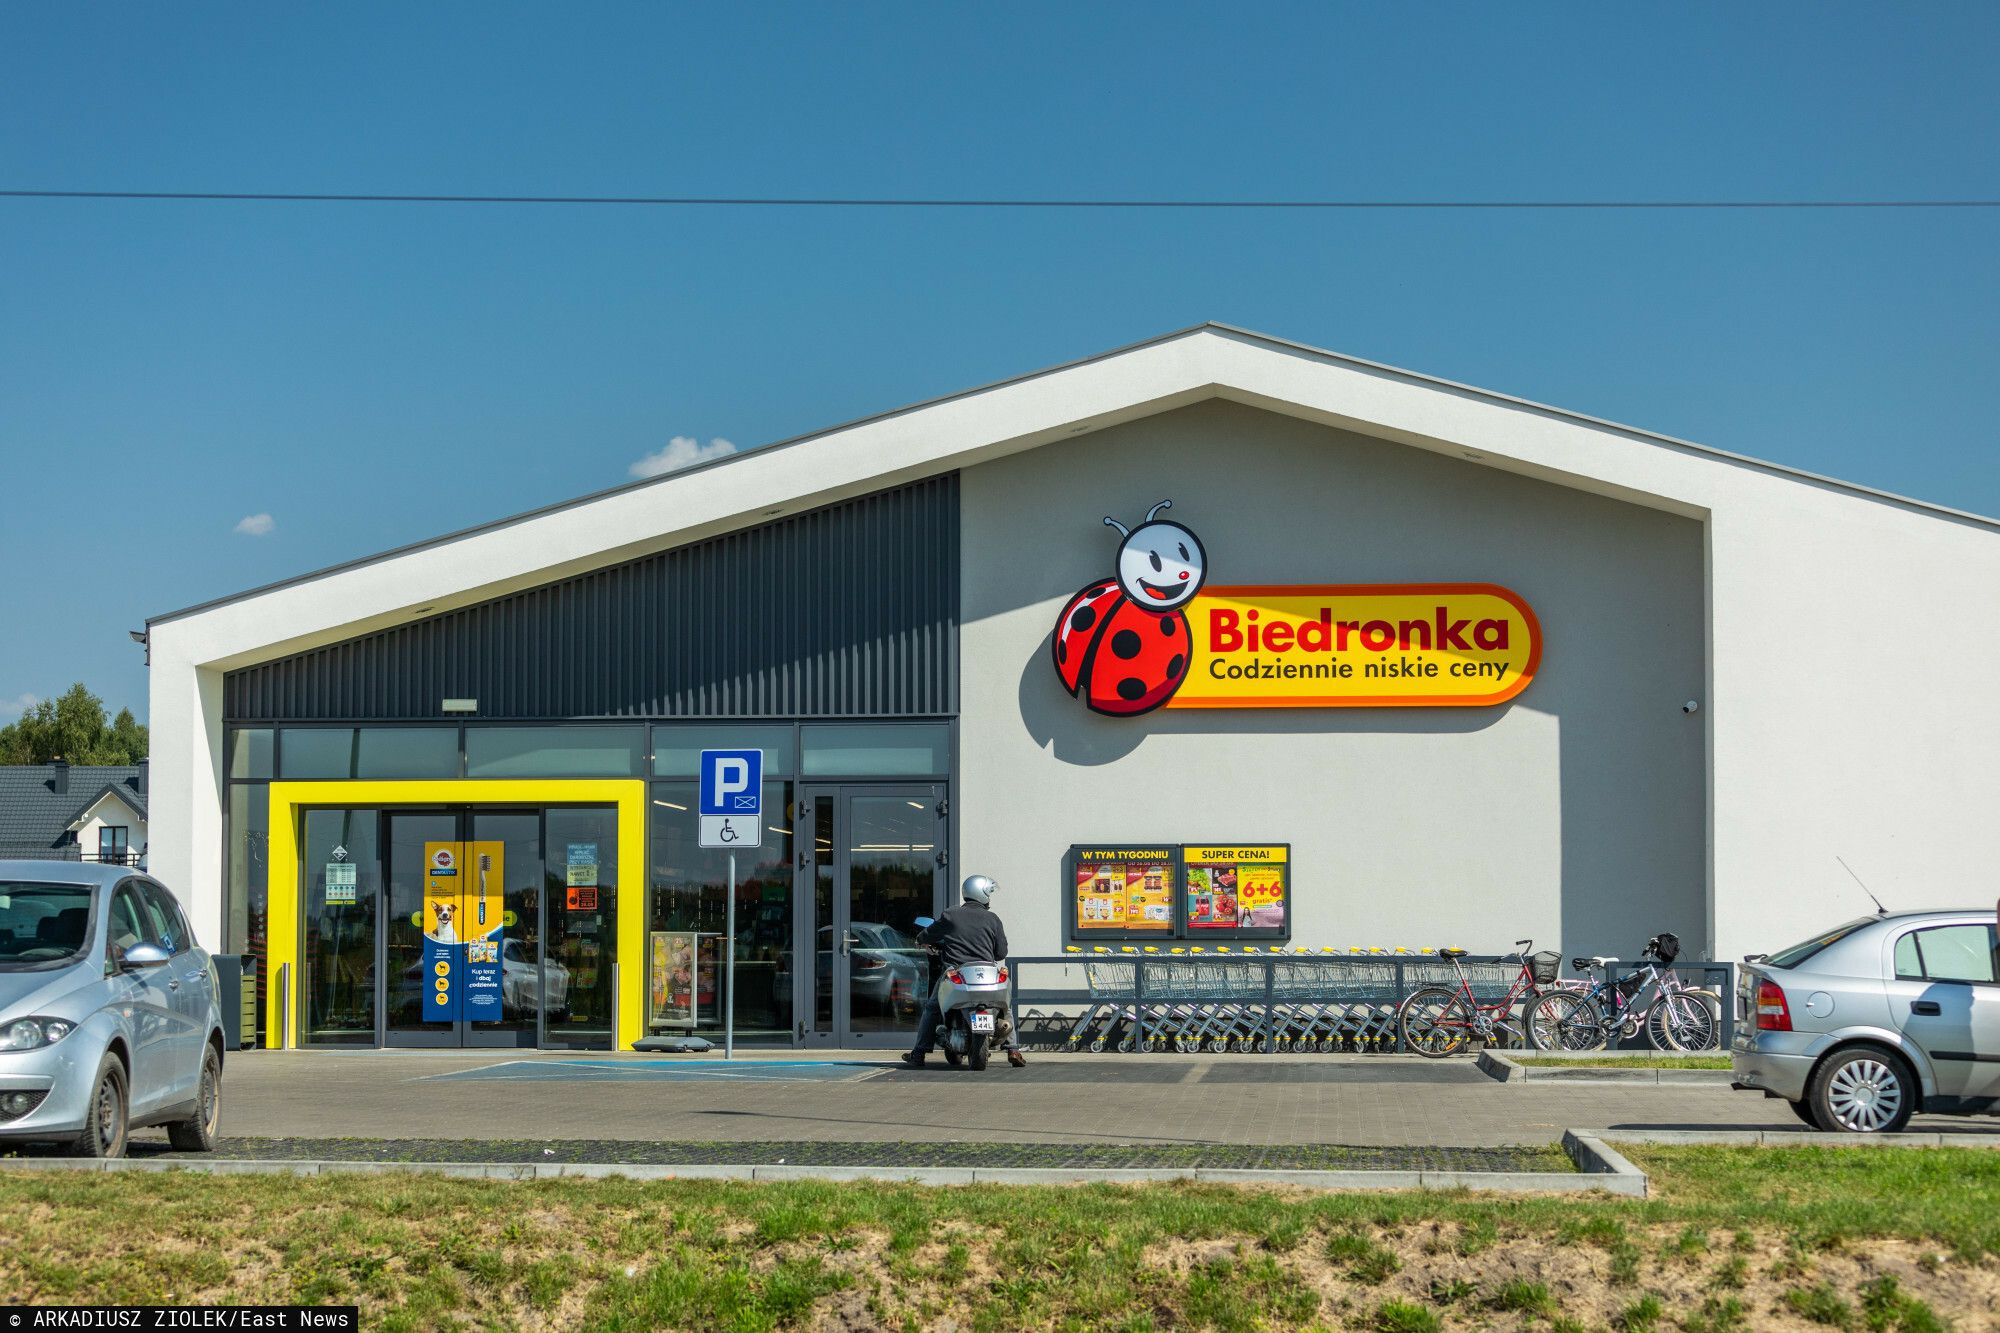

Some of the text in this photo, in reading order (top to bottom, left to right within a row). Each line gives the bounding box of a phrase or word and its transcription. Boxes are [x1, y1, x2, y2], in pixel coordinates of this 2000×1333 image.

[1209, 606, 1509, 653] Biedronka
[1209, 656, 1510, 681] Codziennie niskie ceny
[714, 758, 749, 807] P
[1082, 851, 1169, 859] W TYM TYGODNIU
[1201, 850, 1270, 859] SUPER CENA!
[1242, 881, 1282, 898] 6+6
